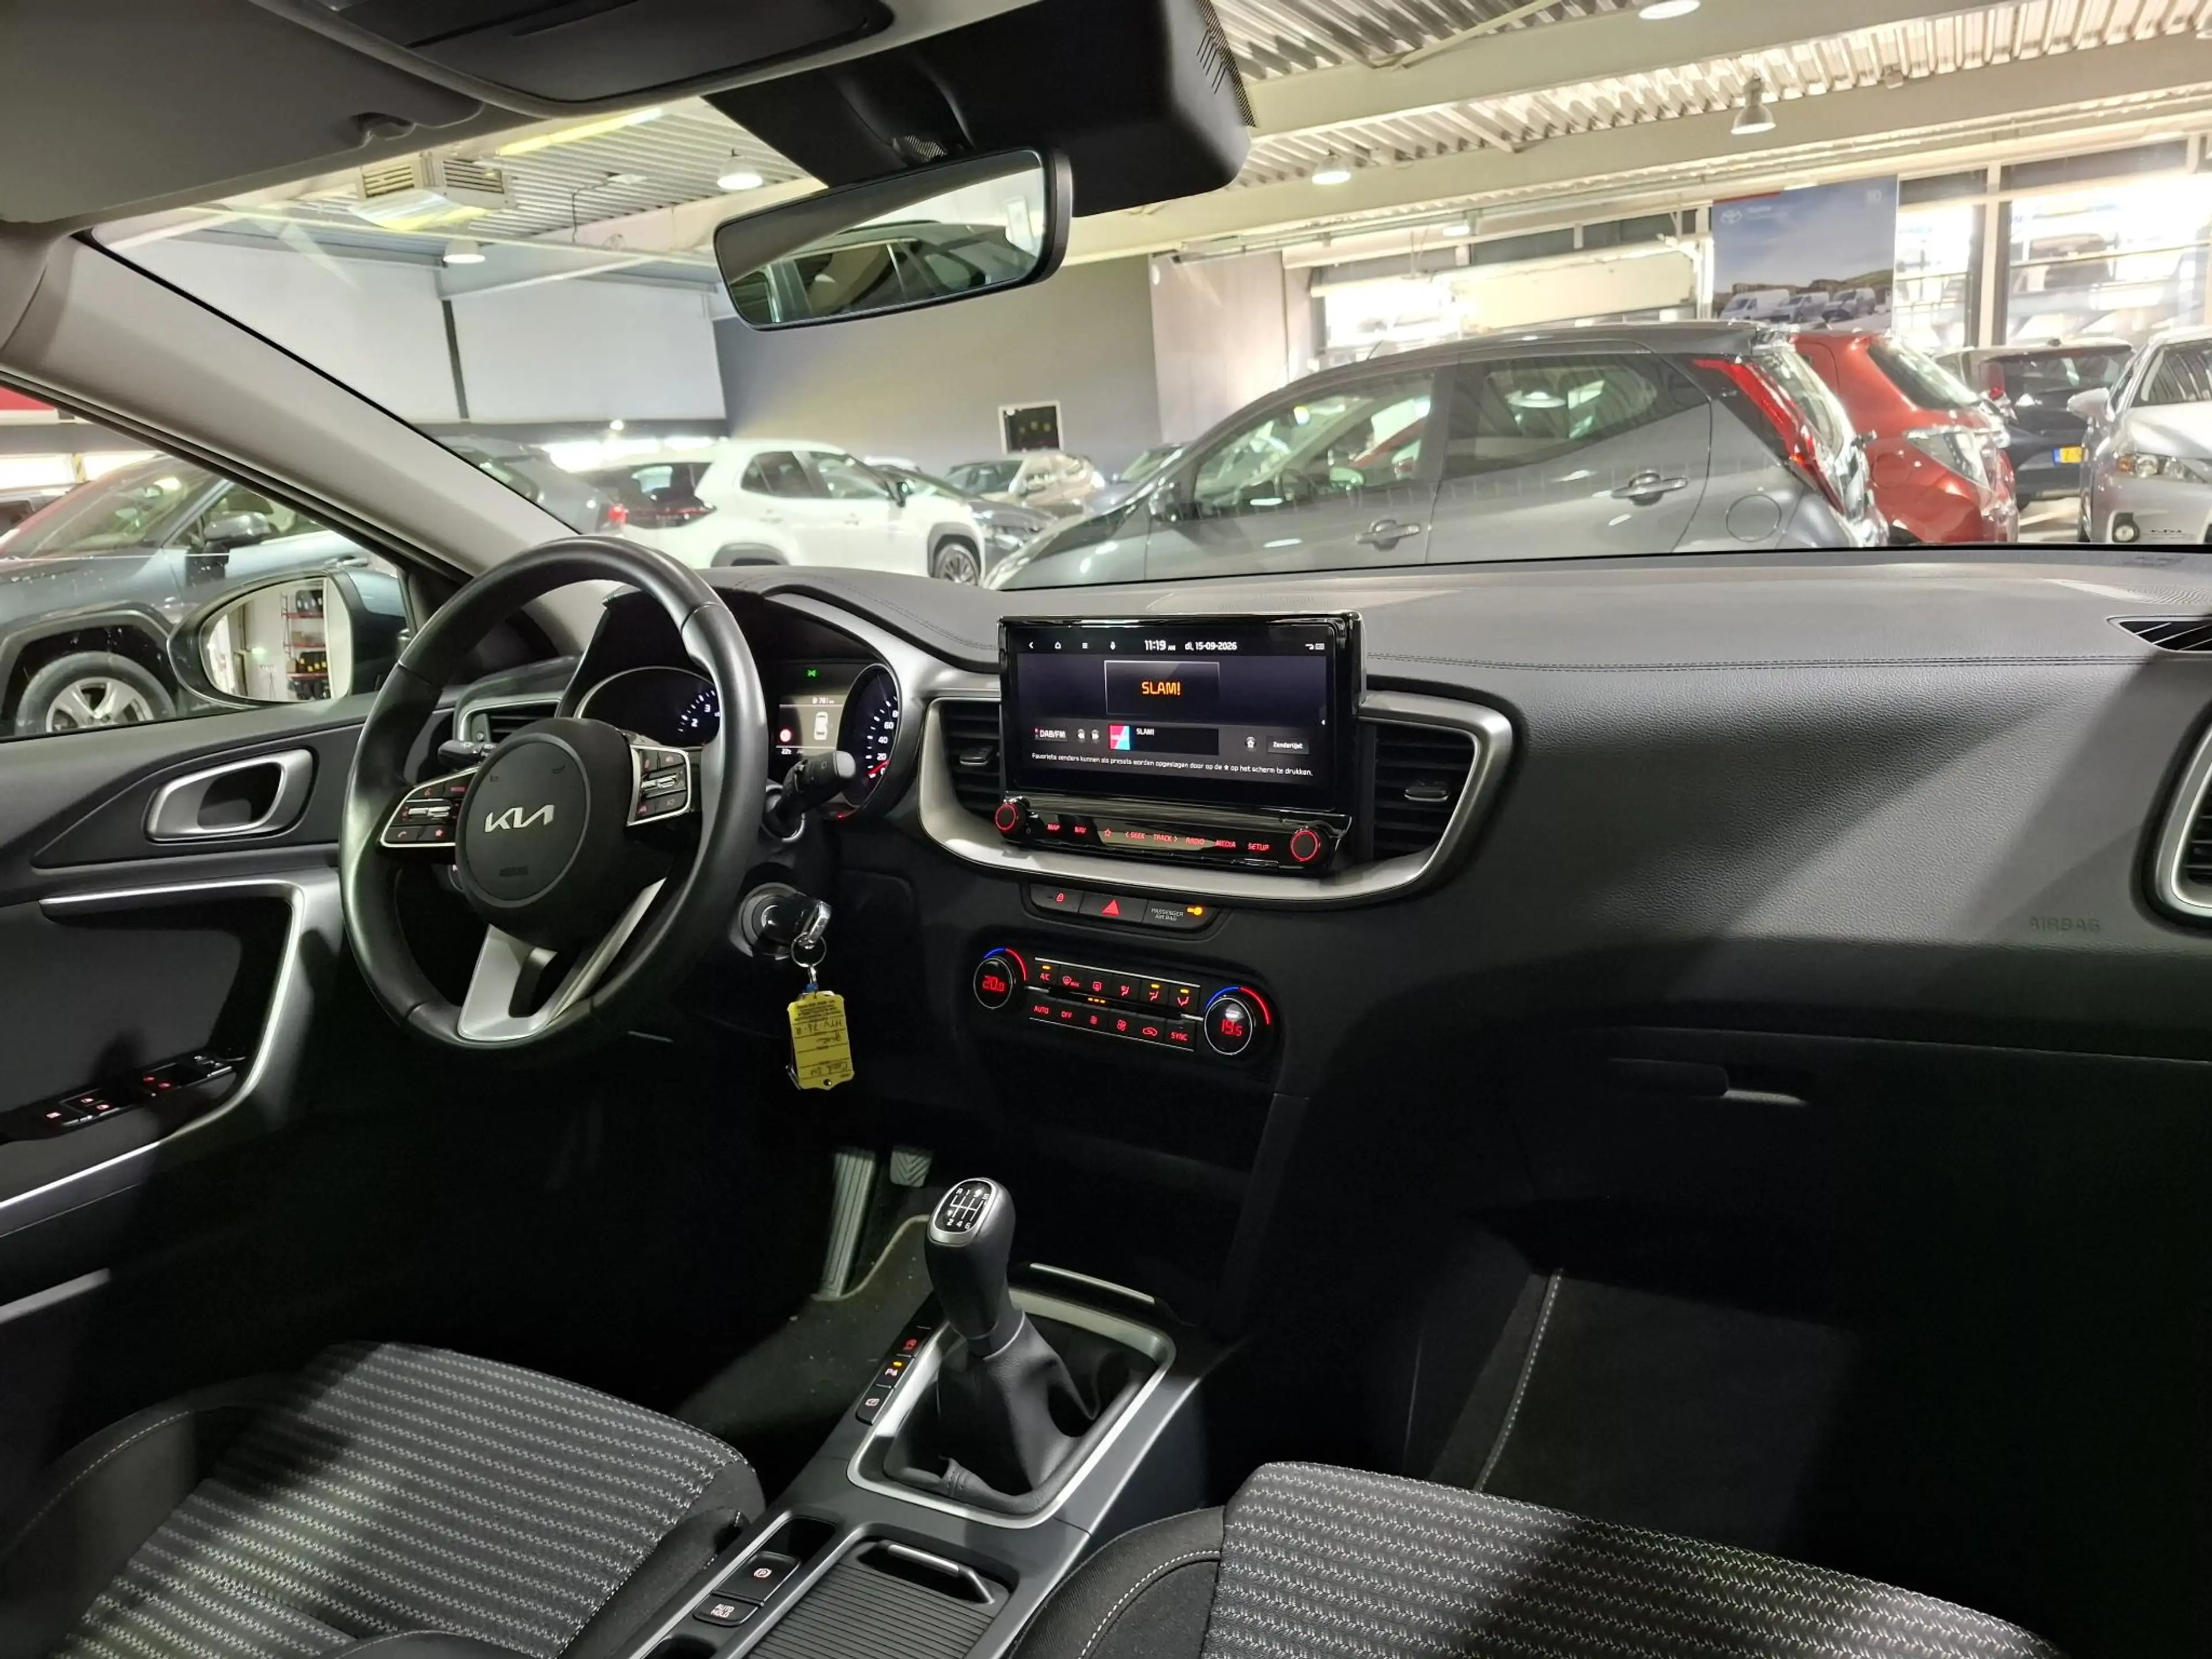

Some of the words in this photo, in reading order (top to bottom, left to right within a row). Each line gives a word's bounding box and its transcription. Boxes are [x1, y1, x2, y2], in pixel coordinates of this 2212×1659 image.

[1145, 639, 1166, 651] 11:19
[1195, 641, 1237, 651] 15-09-2026
[1141, 681, 1181, 696] SLAM!
[704, 704, 711, 713] 3
[691, 718, 698, 728] 2
[884, 721, 895, 730] 60
[1039, 729, 1066, 738] DAB/FM
[878, 736, 889, 744] 40
[877, 752, 887, 761] 20
[1252, 766, 1275, 774] scherm
[484, 804, 555, 833] KIA
[1130, 831, 1146, 839] SEEK
[1153, 834, 1172, 842] TRACK
[1215, 840, 1236, 848] MEDIA
[1247, 842, 1270, 851] SETUP
[1151, 908, 1184, 917] PASSENGER
[2028, 915, 2101, 934] AIRBAG
[1040, 973, 1051, 981] A/C
[1033, 1005, 1050, 1014] AUTO
[1171, 1032, 1188, 1041] SYNC
[946, 1218, 955, 1226] 2
